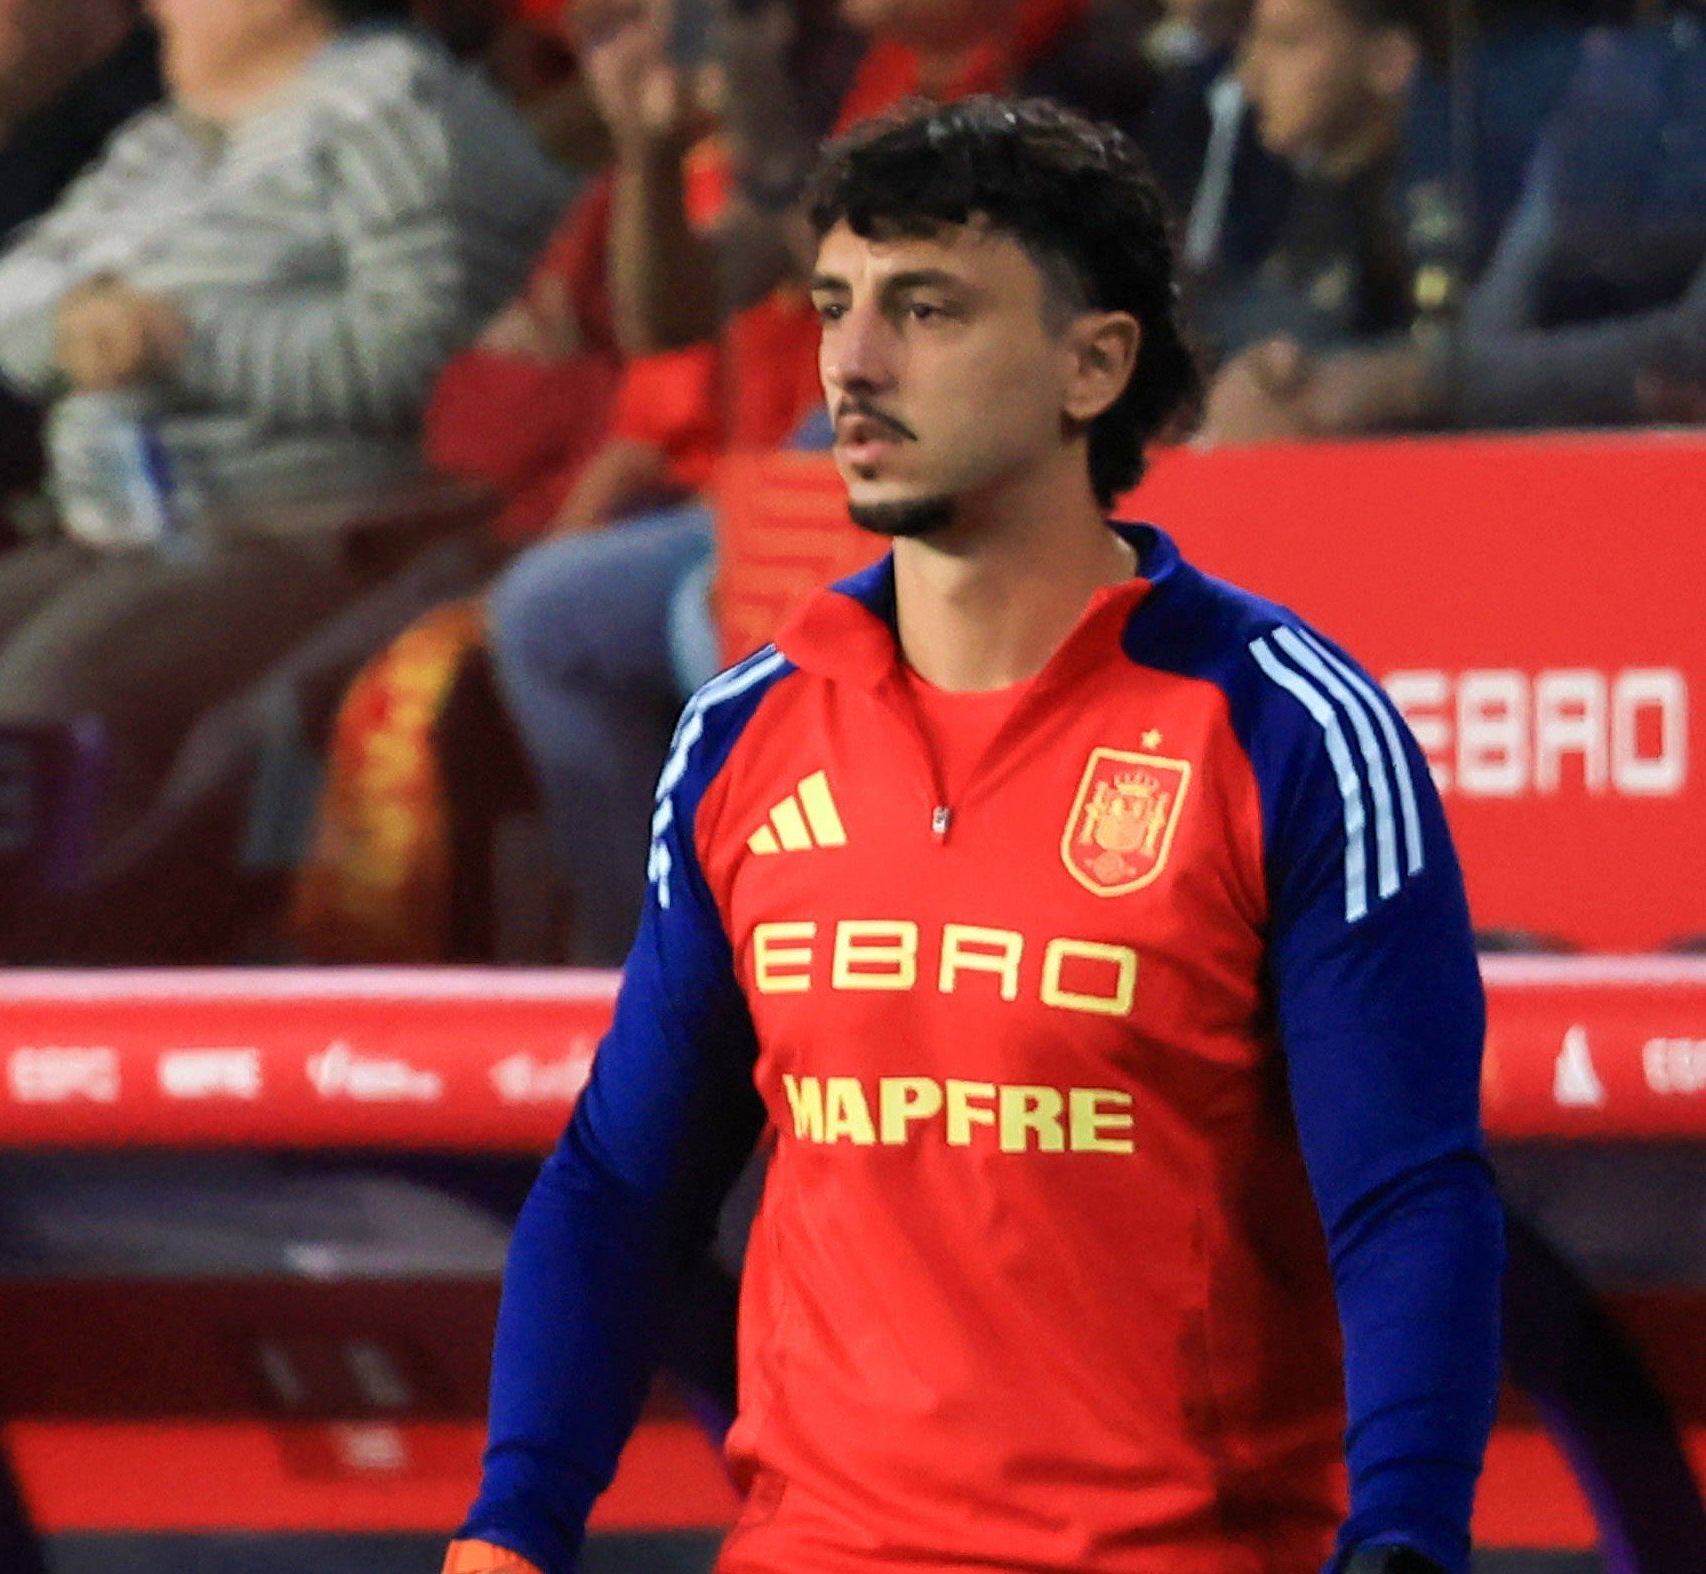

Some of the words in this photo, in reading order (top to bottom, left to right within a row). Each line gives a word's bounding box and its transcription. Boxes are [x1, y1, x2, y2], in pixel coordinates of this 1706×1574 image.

[1383, 667, 1687, 797] EBRO
[753, 919, 1138, 1018] EBRO
[782, 1073, 1135, 1156] MAPFRE
